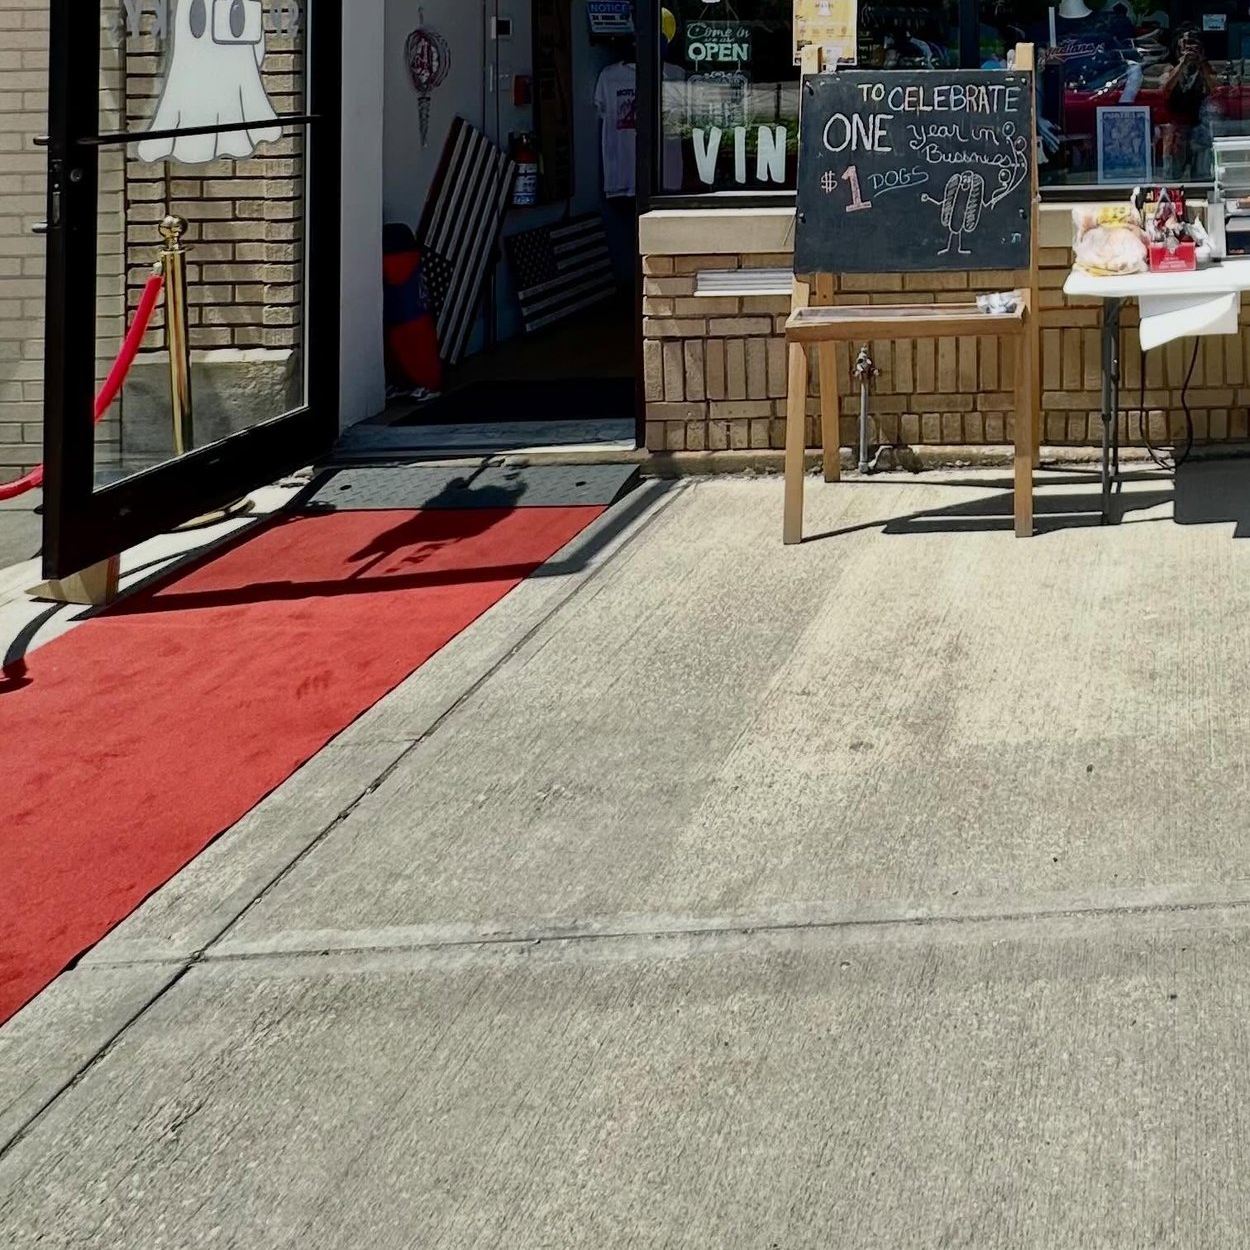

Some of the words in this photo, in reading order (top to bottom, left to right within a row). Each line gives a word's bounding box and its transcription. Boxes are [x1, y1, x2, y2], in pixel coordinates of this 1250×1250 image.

[687, 22, 733, 39] Come
[687, 42, 749, 62] OPEN
[857, 83, 886, 102] TO
[888, 84, 1022, 114] CELEBRATE
[822, 112, 894, 152] ONE
[906, 121, 969, 150] year
[971, 126, 1000, 145] in
[867, 165, 930, 191] DOGS
